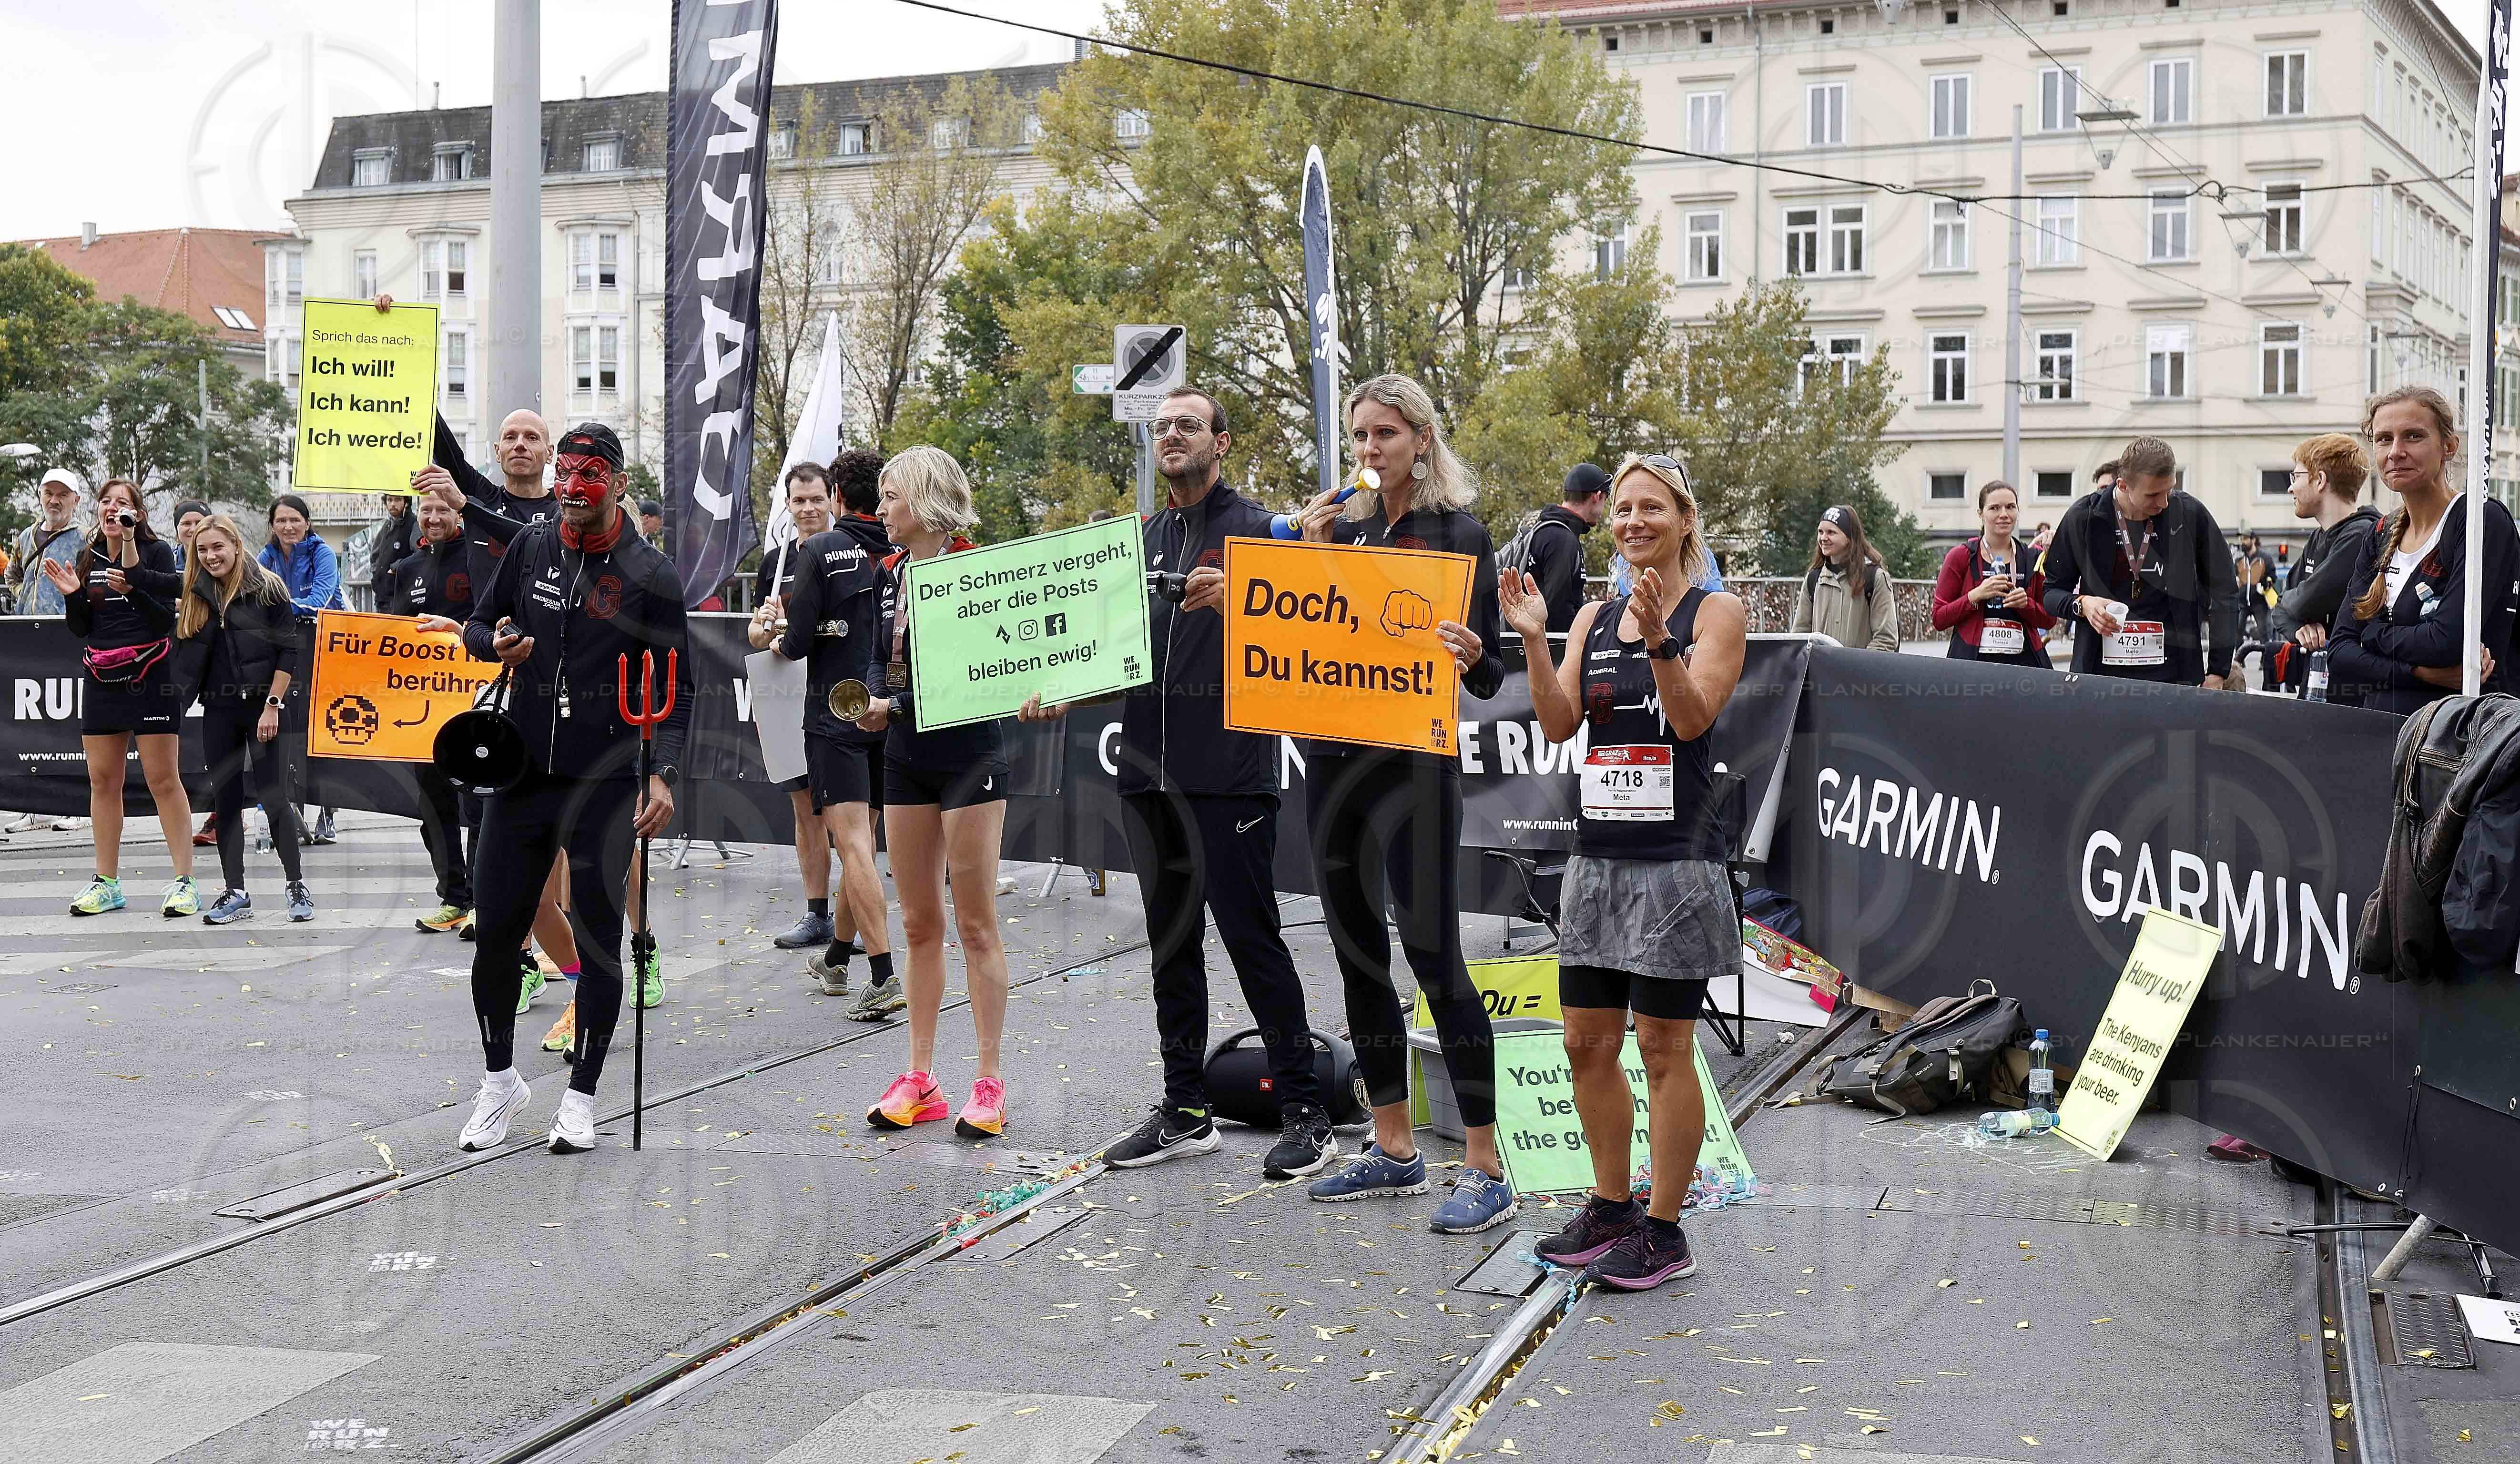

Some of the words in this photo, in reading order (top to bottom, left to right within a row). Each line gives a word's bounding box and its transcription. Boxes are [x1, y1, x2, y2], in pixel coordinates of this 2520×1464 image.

[312, 329, 352, 343] Sprich
[356, 332, 377, 344] das
[382, 335, 414, 346] nach:
[312, 356, 345, 375] Ich
[352, 360, 395, 377] will!
[310, 392, 343, 410] Ich
[350, 394, 409, 413] kann!
[308, 428, 340, 445] Ich
[347, 431, 422, 449] werde!
[920, 582, 953, 600] Der
[959, 563, 1047, 592] Schmerz
[1053, 542, 1132, 573] vergeht,
[957, 598, 1001, 619] aber
[1007, 590, 1037, 609] die
[1044, 578, 1098, 602] Posts
[1243, 578, 1359, 634] Doch,
[1989, 629, 2012, 638] 4808
[2118, 636, 2146, 646] 4791
[328, 632, 371, 654] Für
[377, 636, 458, 661] Boost
[969, 656, 1041, 681] bleiben
[1047, 640, 1097, 666] ewig!
[1123, 655, 1135, 664] WE
[1124, 662, 1140, 673] RUN
[1244, 644, 1290, 681] Du
[1301, 650, 1434, 696] kannst!
[387, 668, 511, 693] berühre
[1587, 667, 1617, 677] ADMIRAL
[14, 678, 84, 720] RU
[1431, 728, 1446, 738] RUN
[1432, 718, 1443, 728] WE
[1600, 770, 1643, 787] 4718
[1818, 767, 2001, 883] GARMIN
[2125, 960, 2162, 996] Hurry
[2160, 978, 2192, 1003] up!
[2102, 1017, 2118, 1040] The
[2117, 1024, 2163, 1059] Kenyans
[2089, 1047, 2103, 1064] are
[2101, 1051, 2144, 1088] drinking
[2074, 1074, 2095, 1093] your
[2093, 1078, 2120, 1106] beer.
[1512, 1130, 1557, 1151] the
[1720, 1163, 1738, 1171] RUN
